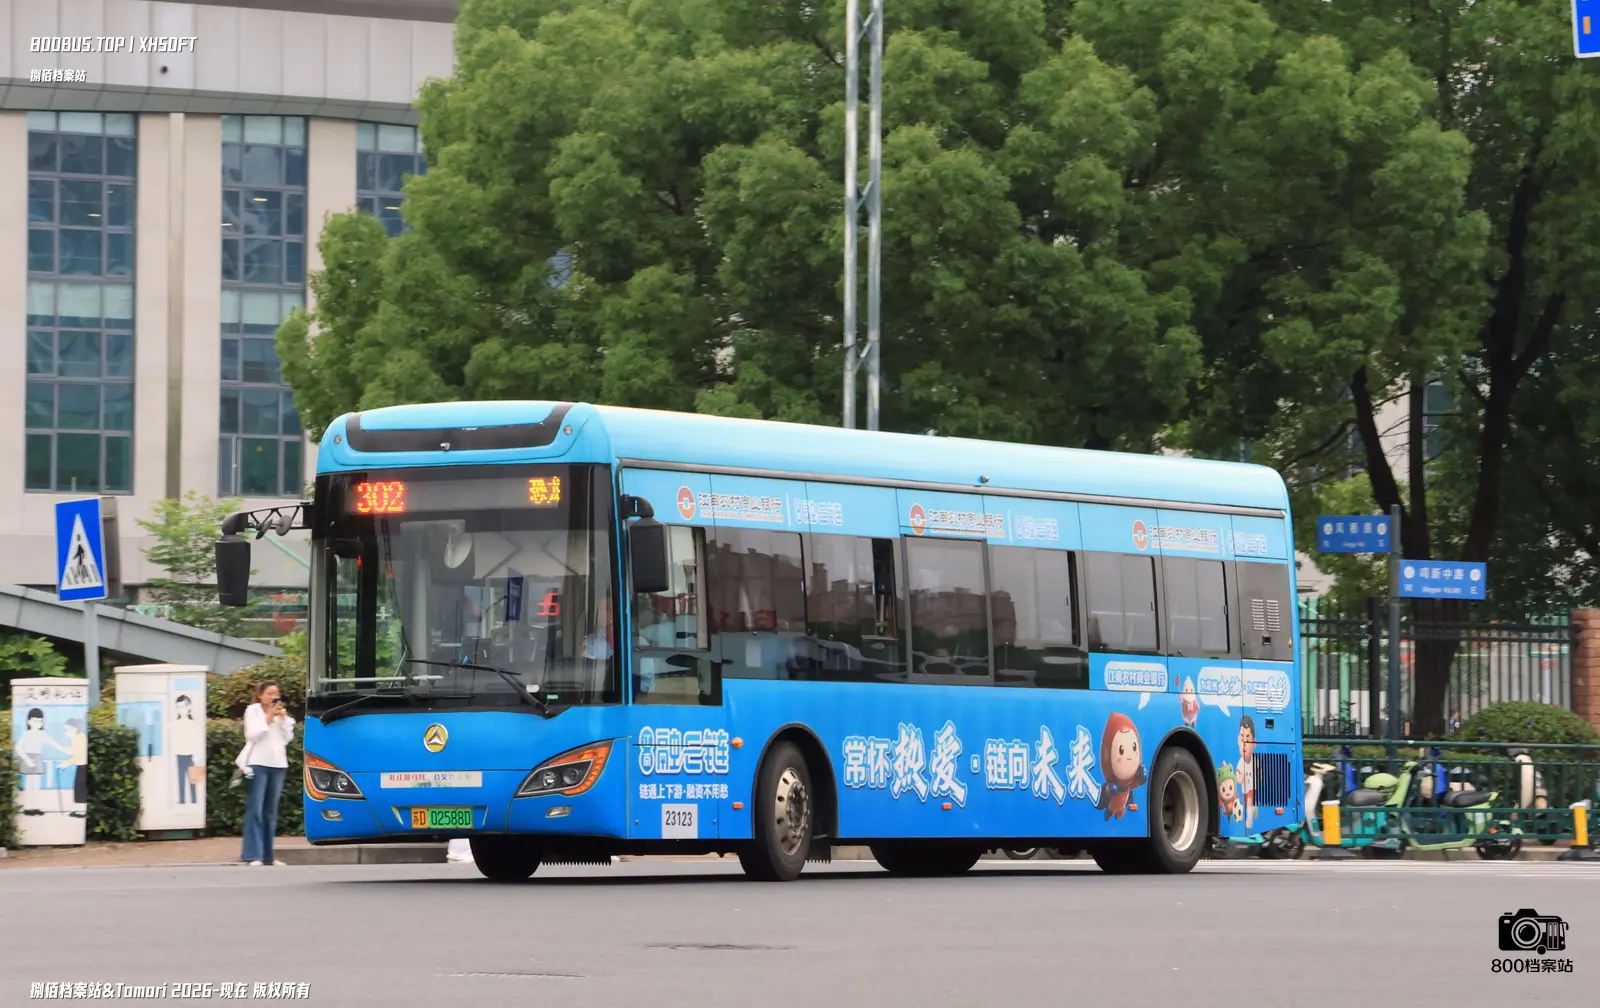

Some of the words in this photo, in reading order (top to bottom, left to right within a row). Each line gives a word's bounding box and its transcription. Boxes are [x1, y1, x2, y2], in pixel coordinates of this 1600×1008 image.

[356, 481, 405, 513] 302
[1107, 668, 1166, 687] 江南农村商业银行
[639, 784, 728, 799] 链通上下游·融资不用愁
[431, 810, 471, 826] 02588D
[665, 810, 693, 827] 23123
